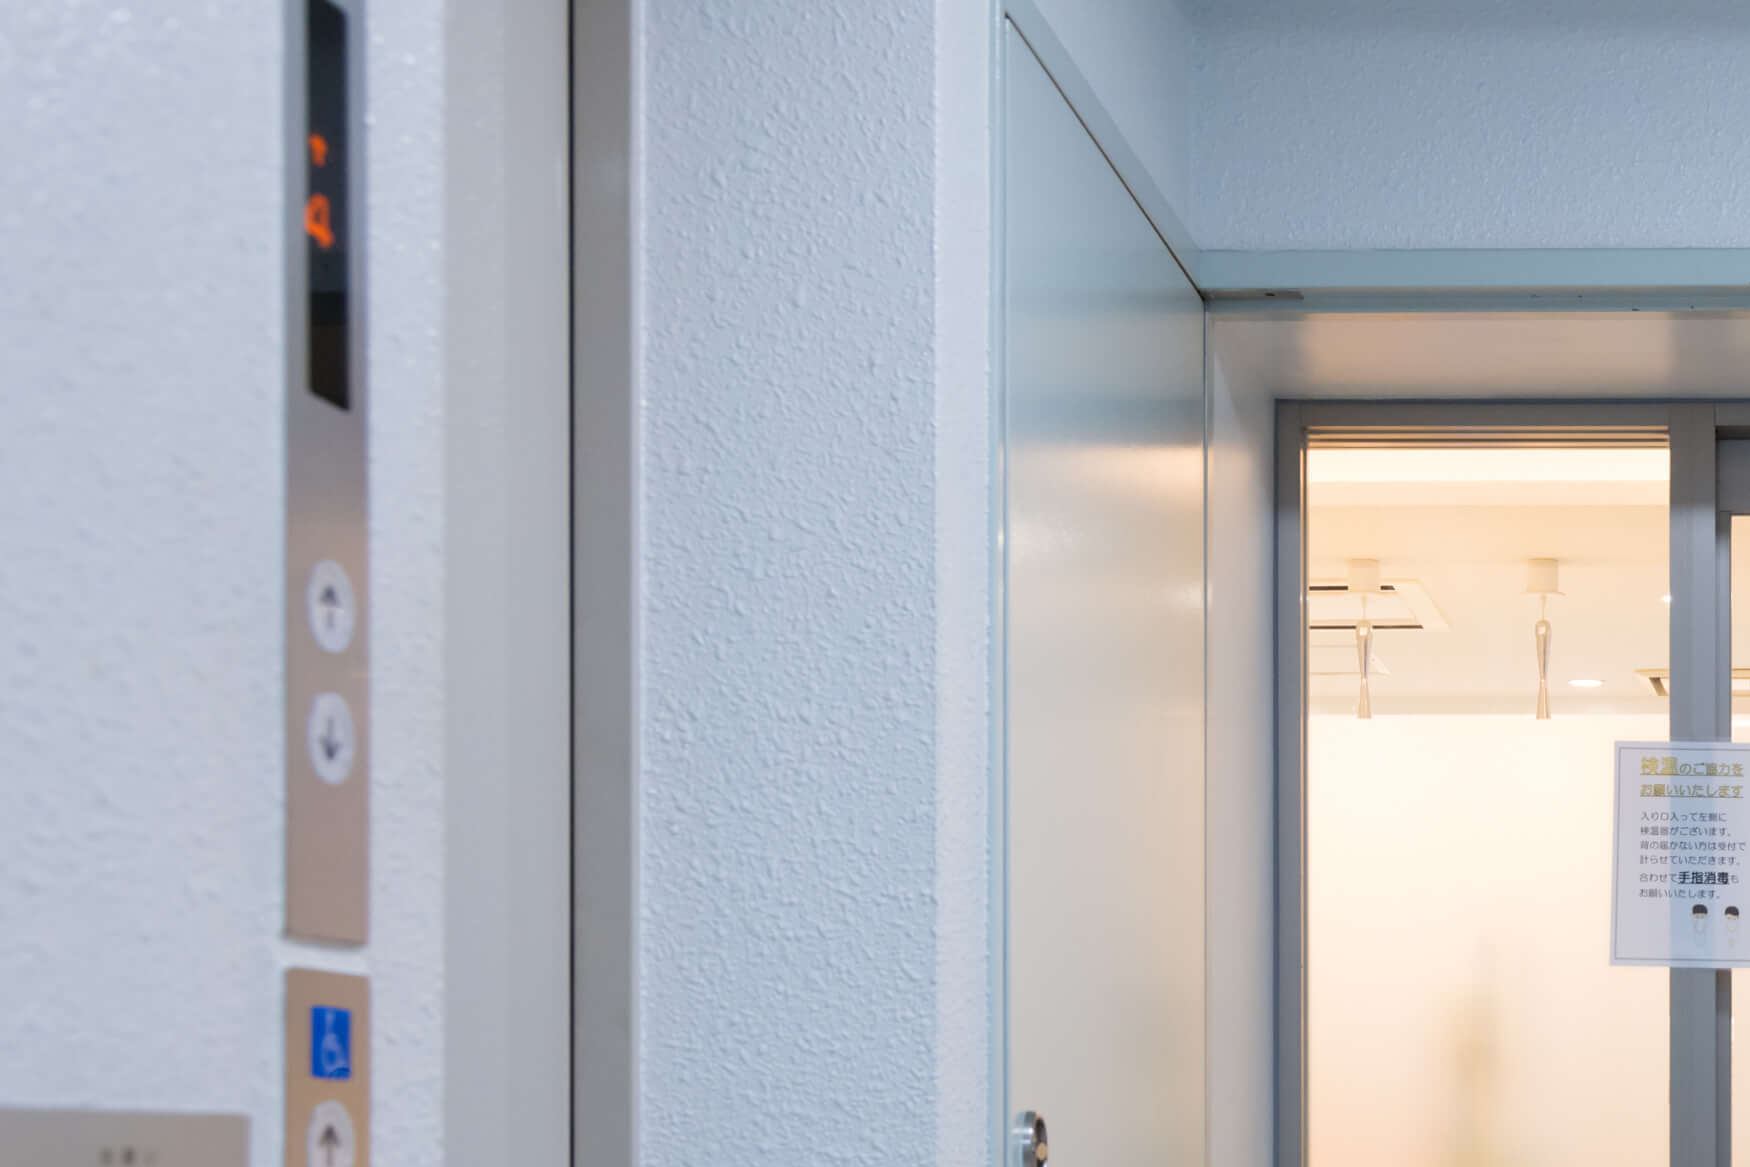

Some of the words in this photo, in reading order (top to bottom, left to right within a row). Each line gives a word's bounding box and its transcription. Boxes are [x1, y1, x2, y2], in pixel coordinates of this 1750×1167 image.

[1640, 757, 1744, 776] 検温のご協力を
[1640, 784, 1744, 798] お願いいたします
